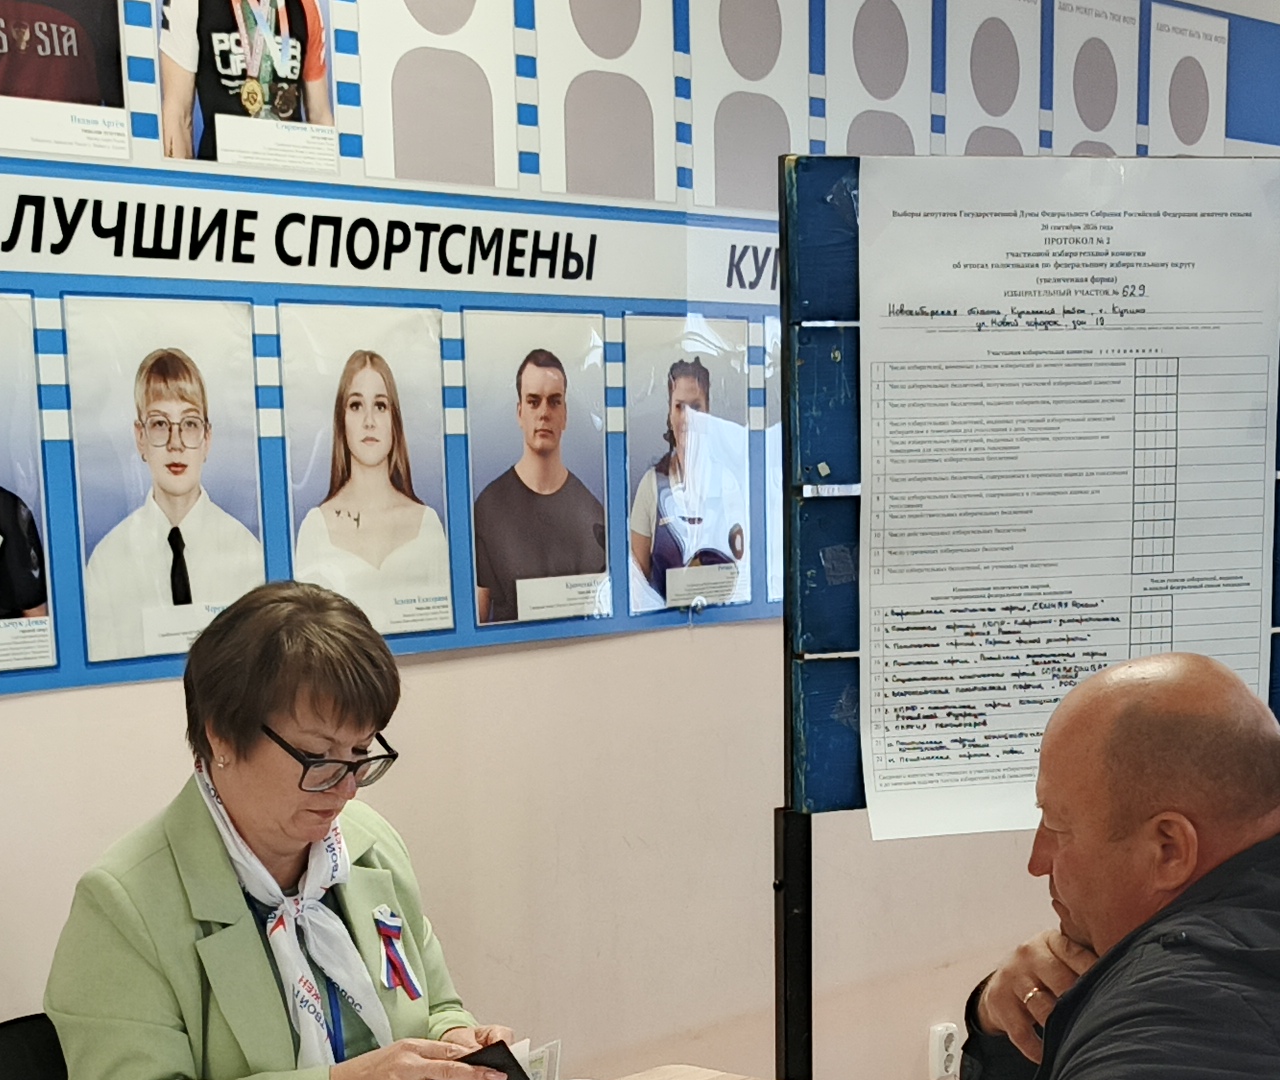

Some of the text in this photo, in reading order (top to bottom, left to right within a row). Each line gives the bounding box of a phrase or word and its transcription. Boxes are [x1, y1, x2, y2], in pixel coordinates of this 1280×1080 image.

[1, 194, 598, 282] ЛУЧШИЕ СПОРТСМЕНЫ
[1044, 236, 1094, 246] ПРОТОКОЛ
[952, 260, 962, 270] об
[1053, 259, 1108, 271] федеральному
[1003, 288, 1071, 298] ИЗБИРАТЕЛЬНЫЙ
[1074, 288, 1112, 298] УЧАСТОК
[1121, 284, 1147, 298] 629
